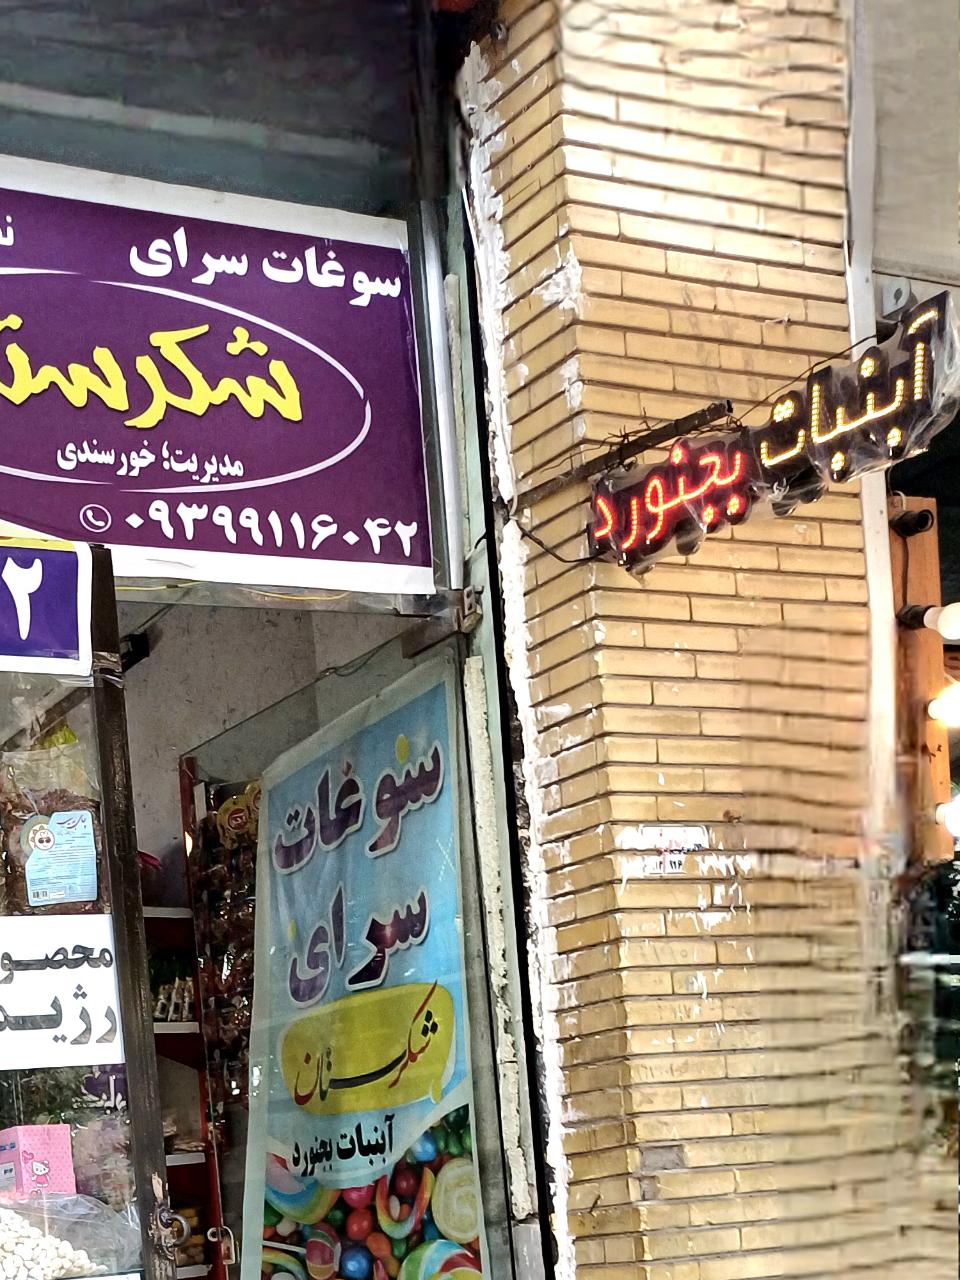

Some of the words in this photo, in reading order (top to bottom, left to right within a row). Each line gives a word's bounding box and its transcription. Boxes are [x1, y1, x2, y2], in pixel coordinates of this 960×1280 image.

[129, 227, 249, 286] سرای
[262, 245, 402, 306] سوغات
[56, 438, 156, 478] خورسندی
[124, 498, 419, 557] ۰۹۳۹۹۱۱۶۰۴۲
[592, 444, 743, 552] بجنورد
[271, 738, 446, 872] سوغات
[288, 884, 429, 1006] سرای
[292, 1136, 334, 1177] بجنورد
[336, 1112, 396, 1167] آبنبات
